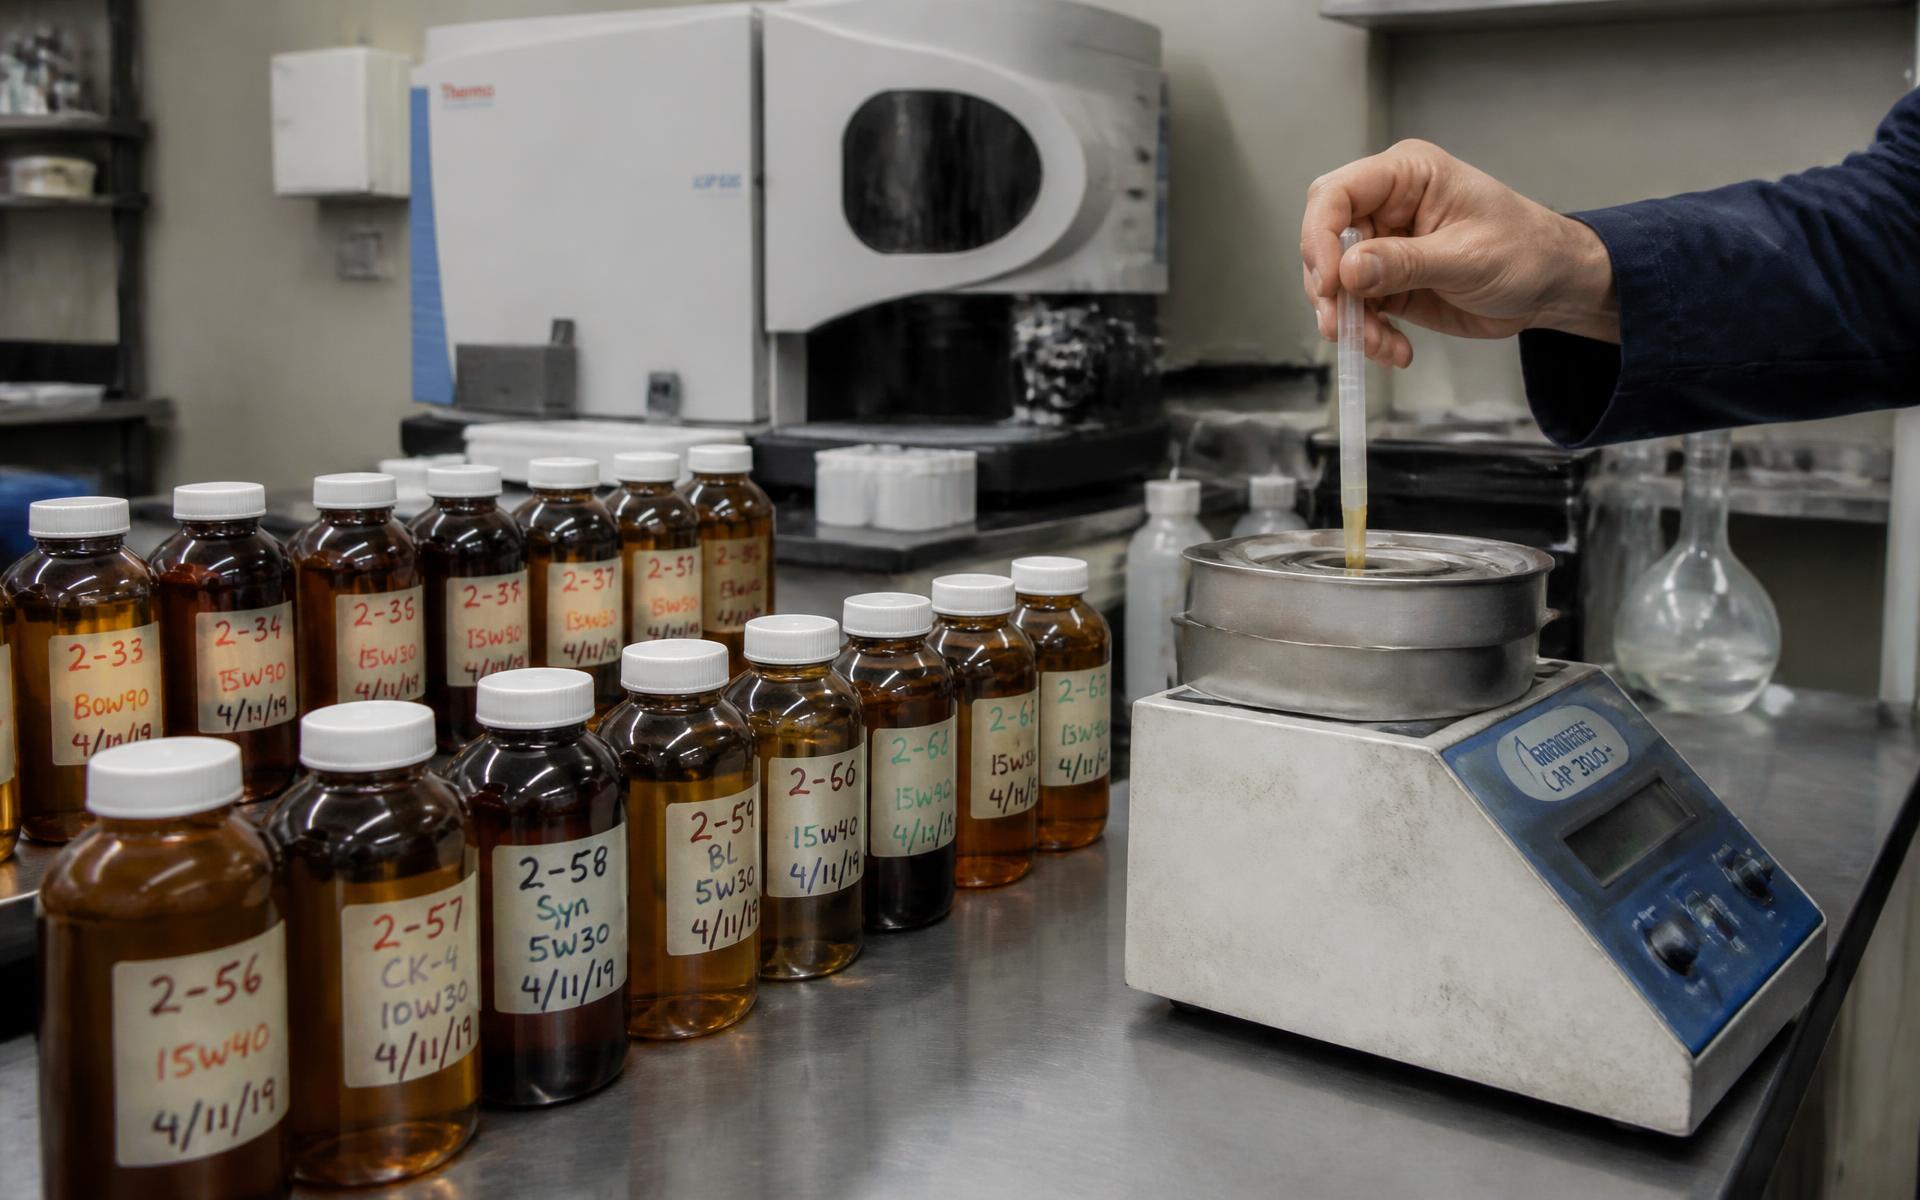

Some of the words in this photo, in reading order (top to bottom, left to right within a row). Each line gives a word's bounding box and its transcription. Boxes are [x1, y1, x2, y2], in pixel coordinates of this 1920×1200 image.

[215, 616, 281, 647] 2-34
[68, 638, 144, 672] 2-33
[355, 672, 419, 700] 4/11/19
[217, 694, 287, 731] 4/11/19
[690, 798, 754, 843] 2-59
[794, 816, 858, 849] 15W40
[519, 845, 608, 891] 2-58
[708, 841, 738, 870] BL
[790, 849, 859, 894] 4/11/19
[696, 865, 754, 905] 5W30
[373, 896, 463, 951] 2-57
[537, 895, 589, 929] Syn
[691, 898, 759, 950] 4/11/19
[529, 923, 610, 962] 5W30
[150, 953, 262, 1016] 2-56
[382, 946, 458, 988] CK-4
[521, 958, 614, 1012] 4/11/19
[382, 980, 469, 1030] 10W30
[156, 1023, 271, 1081] 15W40
[374, 1015, 472, 1081] 4/11/19
[152, 1079, 276, 1152] 4/11/19
